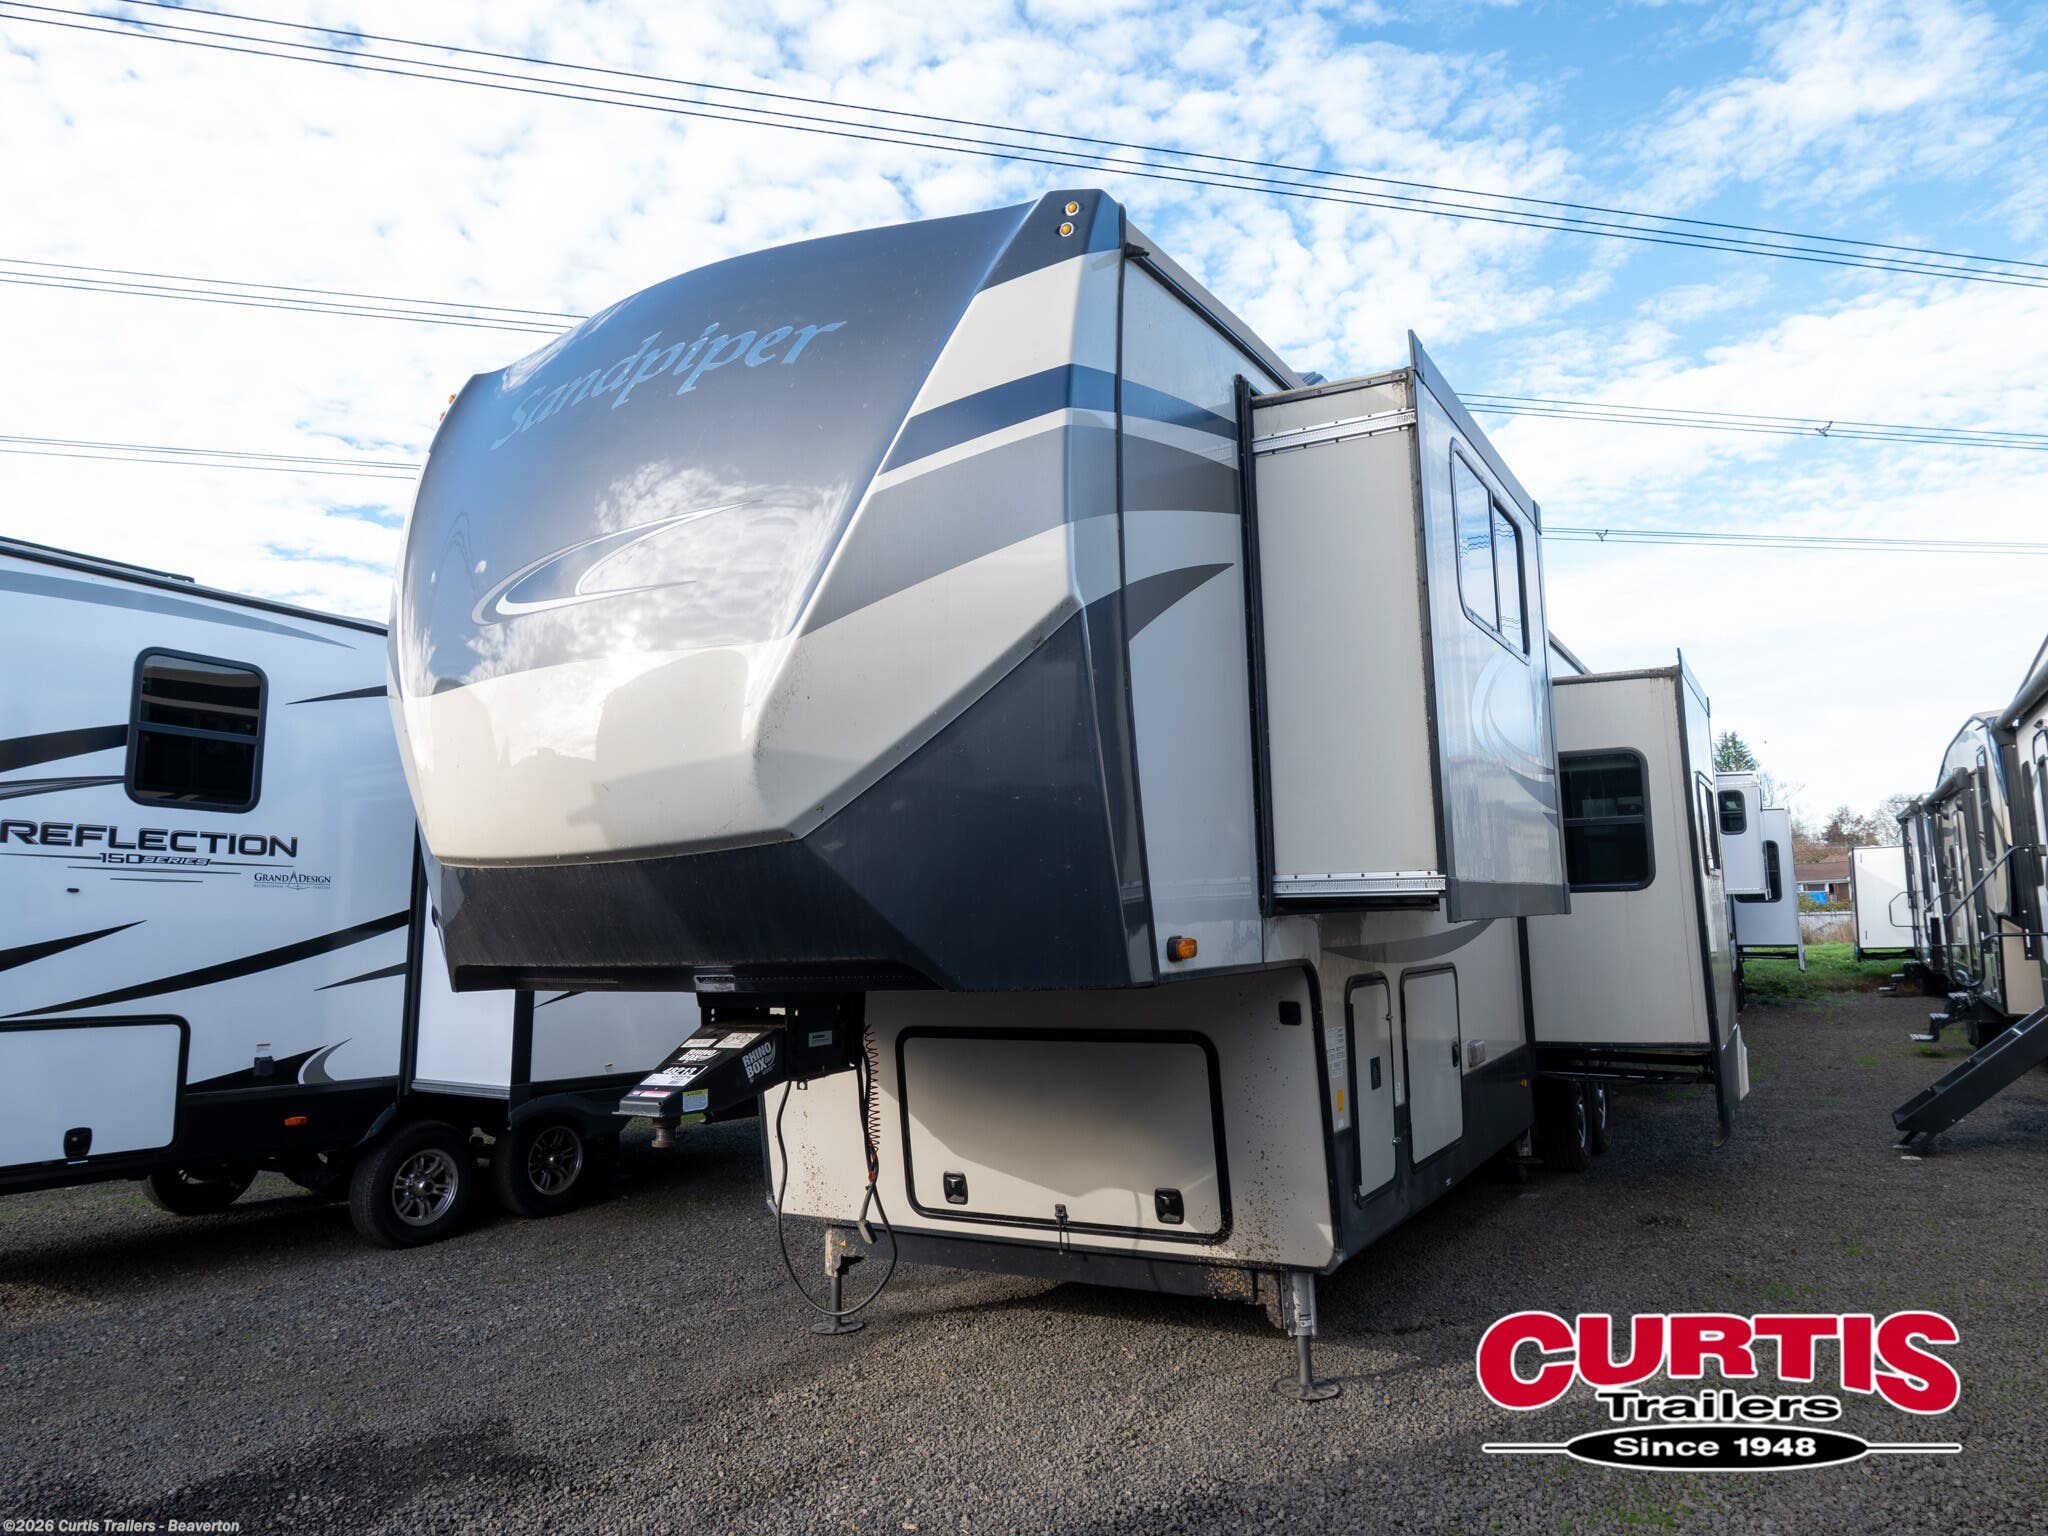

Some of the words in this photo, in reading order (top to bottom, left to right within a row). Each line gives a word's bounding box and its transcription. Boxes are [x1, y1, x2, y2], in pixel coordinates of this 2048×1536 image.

[490, 321, 847, 451] Sandpiper
[0, 818, 298, 858] REFLECTION
[100, 853, 142, 864] 150
[142, 856, 211, 866] SERIES
[254, 872, 289, 882] GRAND
[298, 873, 331, 884] DESIGN
[742, 1041, 772, 1067] RHINO
[745, 1058, 768, 1079] BOX
